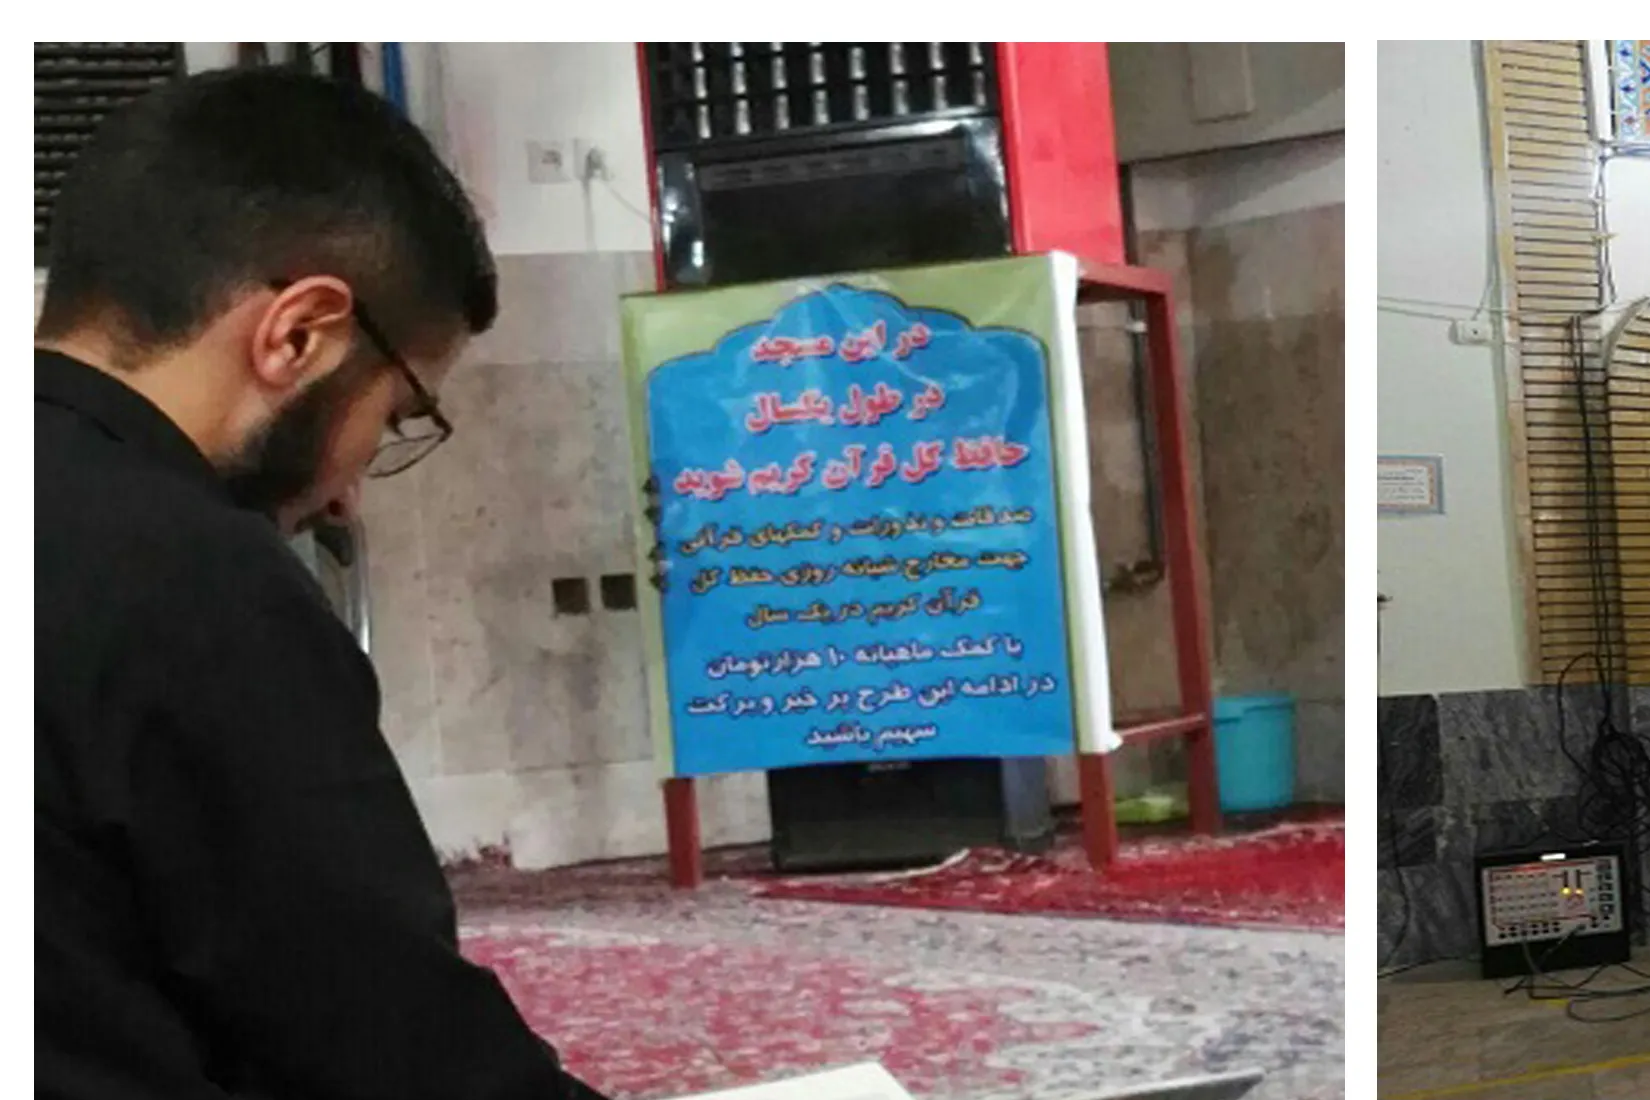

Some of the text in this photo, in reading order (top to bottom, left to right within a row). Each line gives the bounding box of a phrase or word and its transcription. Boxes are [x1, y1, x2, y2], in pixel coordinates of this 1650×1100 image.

[751, 319, 932, 367] در این مسجد
[745, 382, 945, 433] در طول یکسال
[673, 434, 1030, 501] حافظ کل قرآن کریم شوید
[678, 522, 744, 555] قرآنی
[828, 523, 844, 544] و
[904, 551, 972, 582] مخارج
[976, 550, 1030, 571] جهت
[690, 566, 721, 594] کل
[726, 565, 775, 587] حفظ
[746, 587, 982, 630] قرآن کریم در یک سال
[854, 642, 934, 670] ماهیانه
[939, 635, 1000, 659] کمک
[1003, 634, 1023, 660] با
[857, 682, 913, 713] طرح
[917, 679, 955, 708] این
[960, 674, 1020, 696] ادامه
[1026, 673, 1056, 698] در
[780, 688, 819, 714] خیر
[806, 723, 938, 750] سهیم باشید
